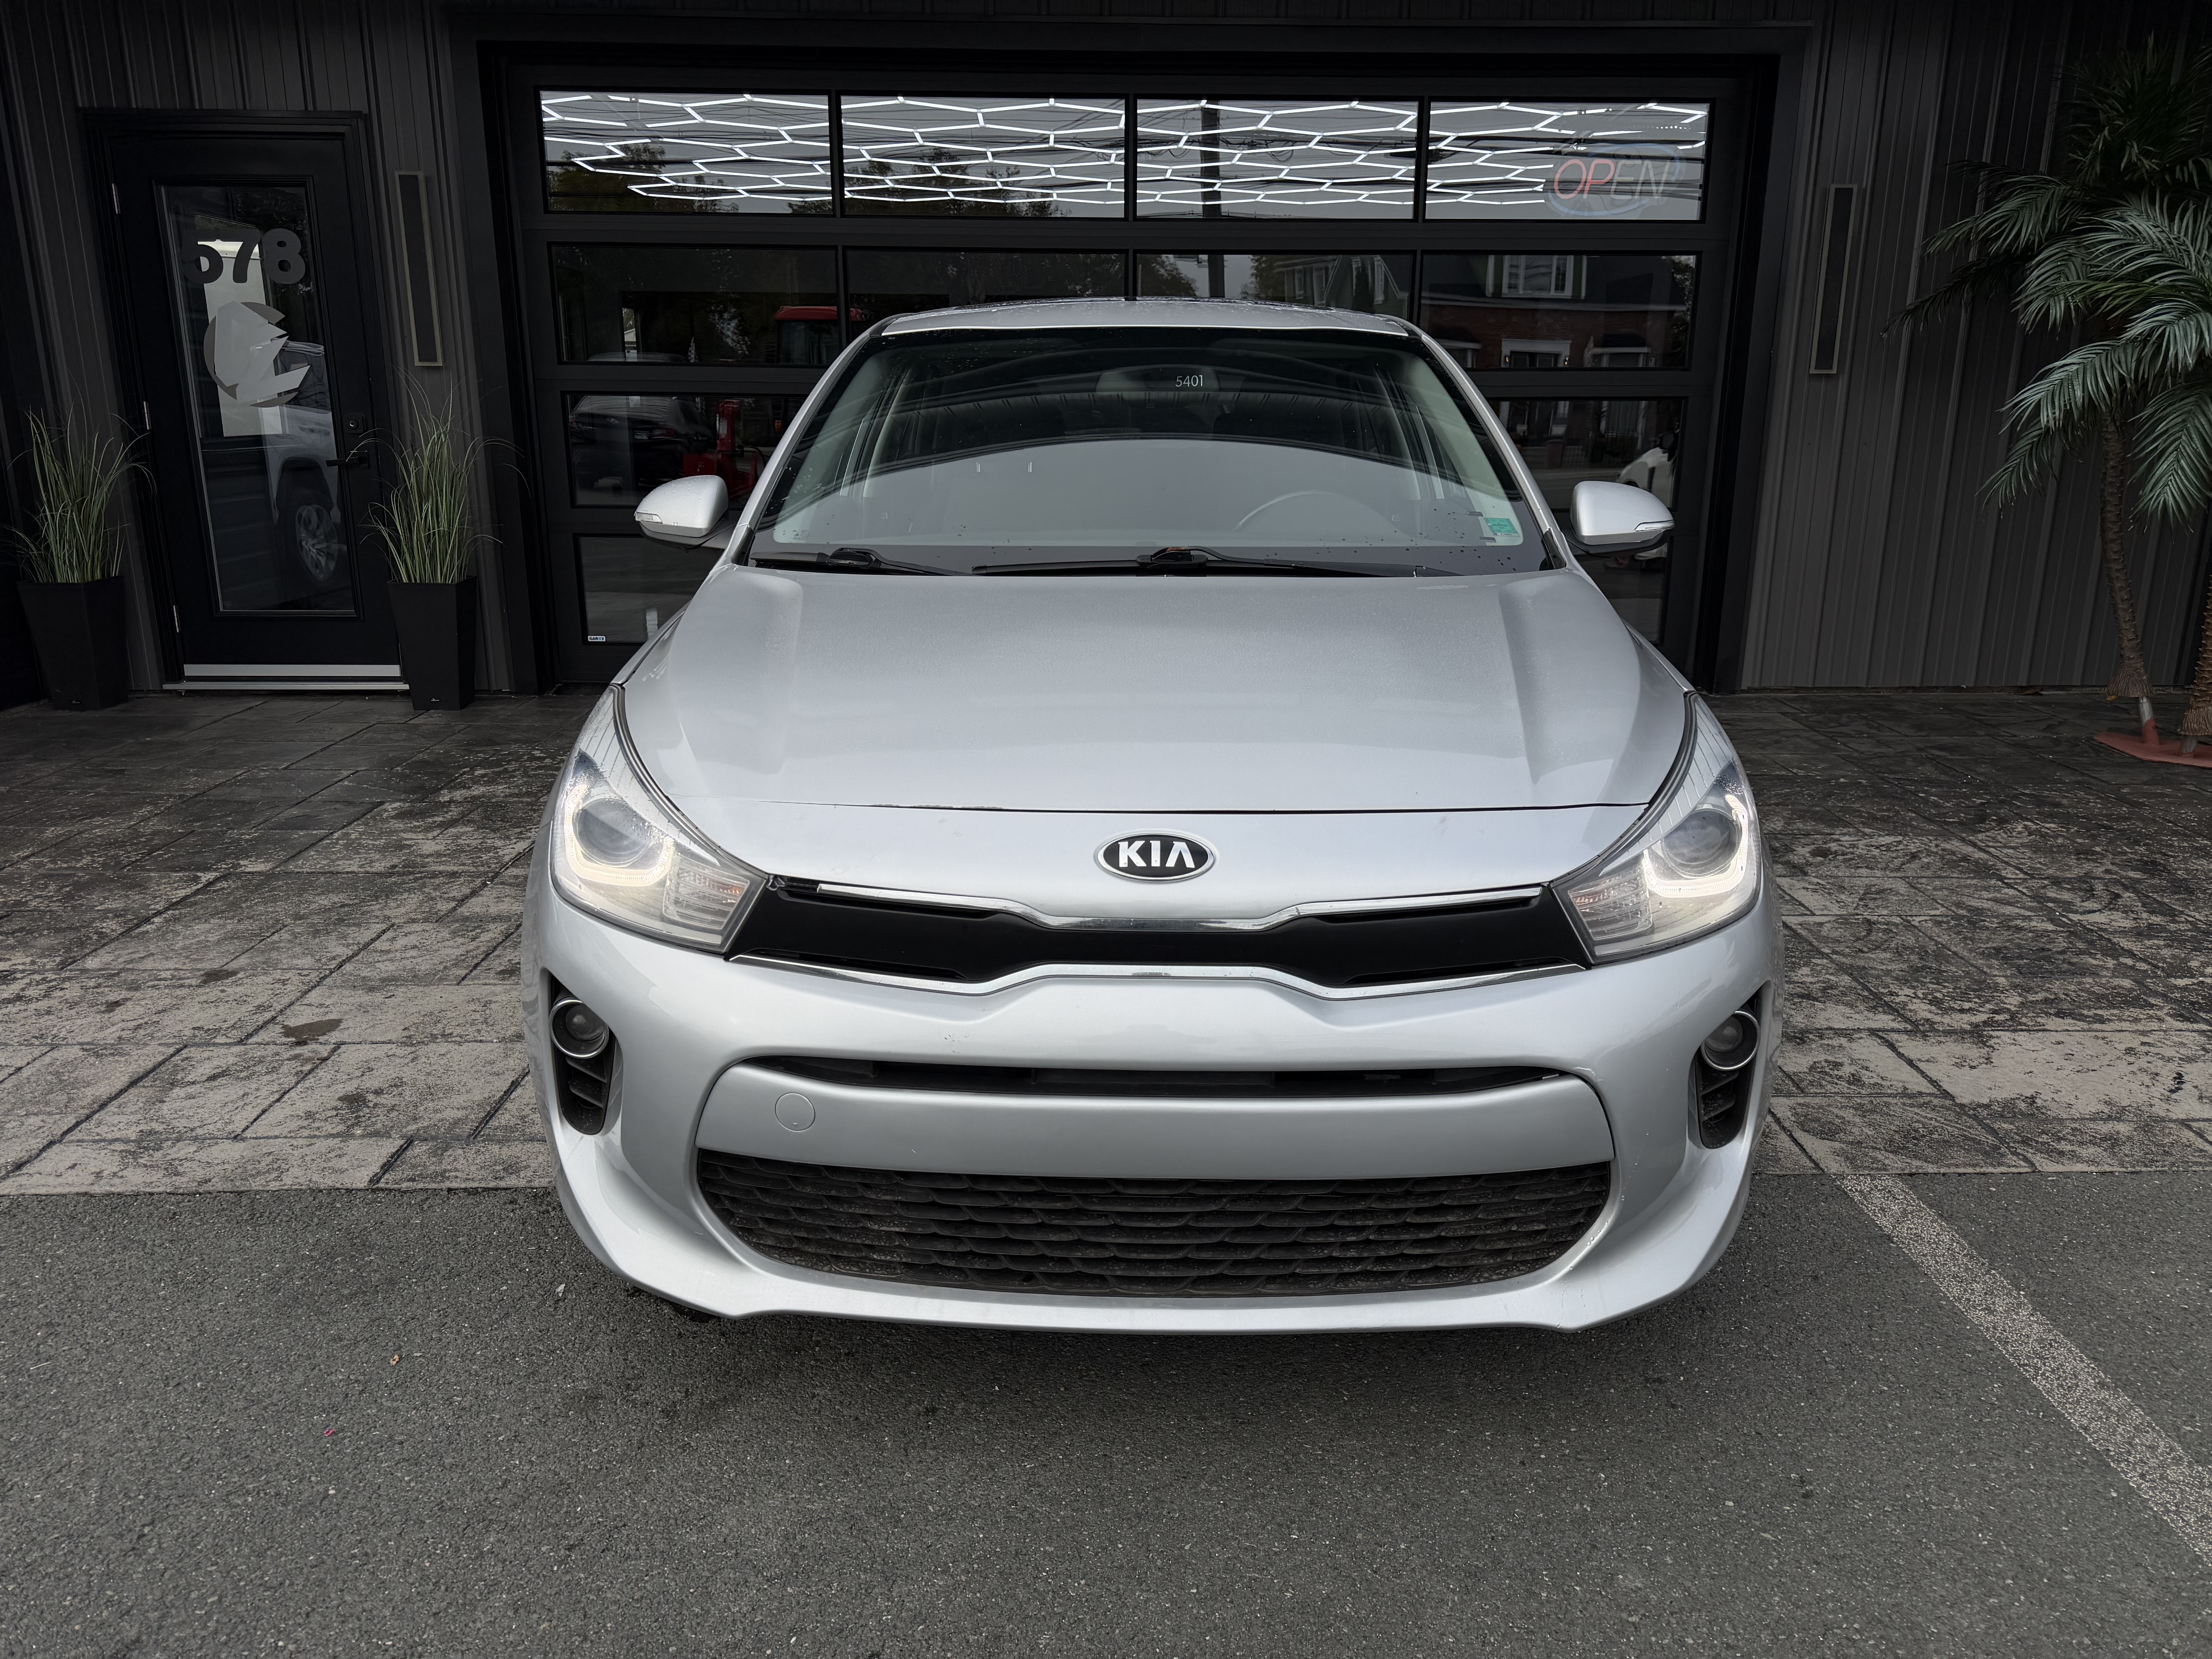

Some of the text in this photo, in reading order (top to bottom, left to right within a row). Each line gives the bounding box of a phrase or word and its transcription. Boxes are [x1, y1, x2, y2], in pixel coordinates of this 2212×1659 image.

[1554, 159, 1670, 200] OPEN
[181, 228, 306, 285] 578
[1175, 374, 1204, 388] 5401
[1118, 840, 1195, 868] KIA
